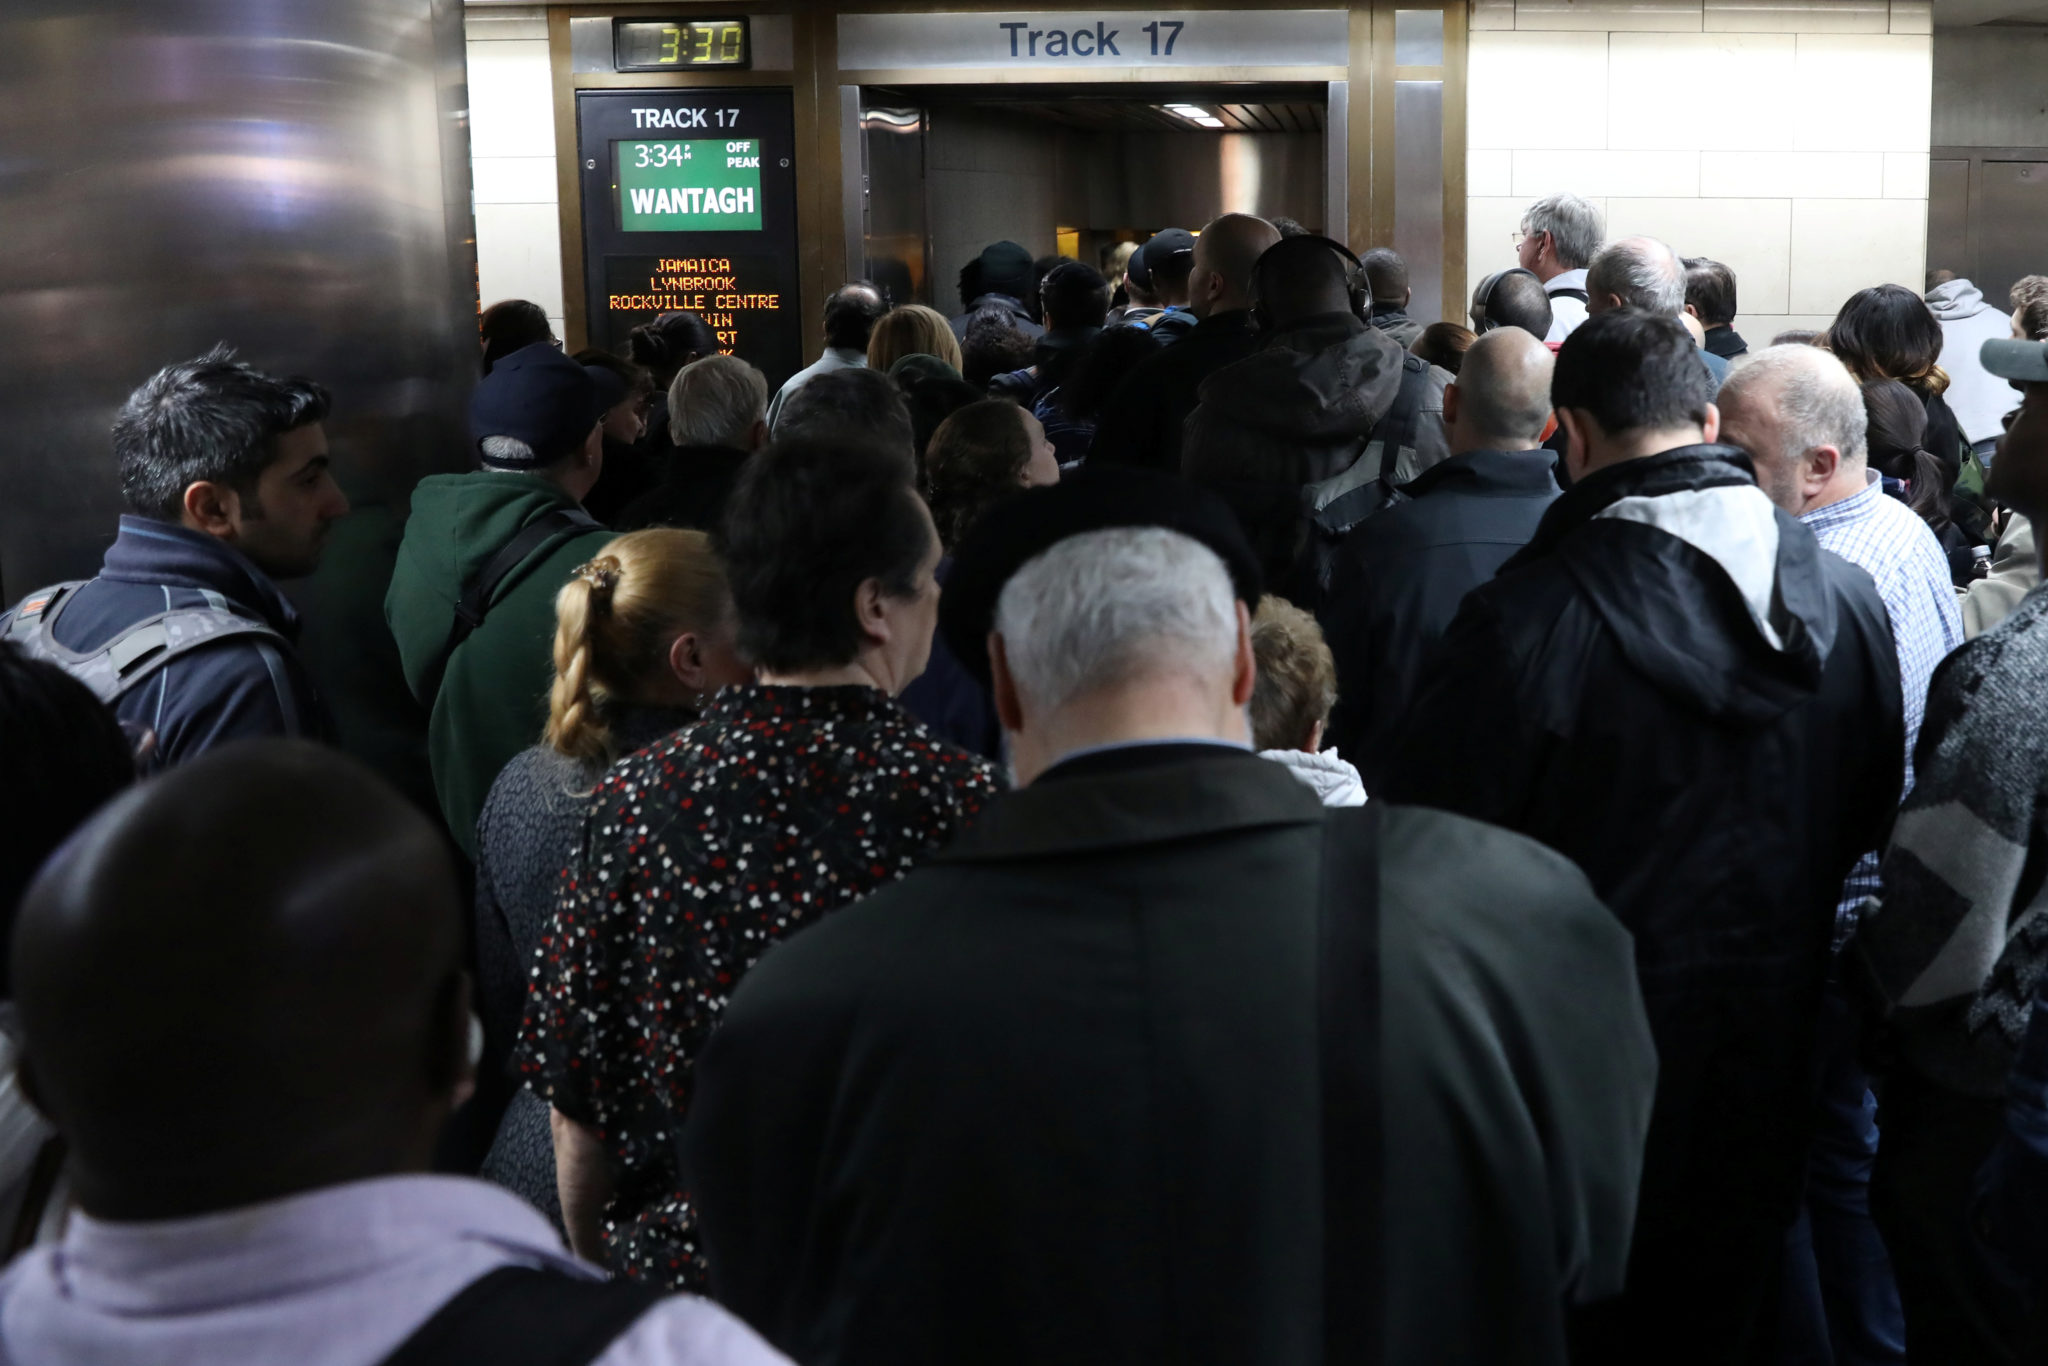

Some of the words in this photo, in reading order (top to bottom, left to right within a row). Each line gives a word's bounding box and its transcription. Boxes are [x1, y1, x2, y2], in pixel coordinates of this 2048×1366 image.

[659, 27, 741, 63] 3:30
[1000, 21, 1121, 57] Track
[1142, 21, 1185, 56] 17
[631, 108, 708, 128] TRACK
[715, 108, 740, 128] 17
[726, 141, 751, 153] OFF
[634, 144, 683, 168] 3:34
[727, 157, 760, 168] PEAK
[630, 187, 754, 214] WANTAGH
[656, 259, 730, 273] JAMAICA
[651, 276, 736, 291] LYNBROOK
[609, 295, 705, 309] ROCKVILLE
[715, 294, 779, 309] CENTRE
